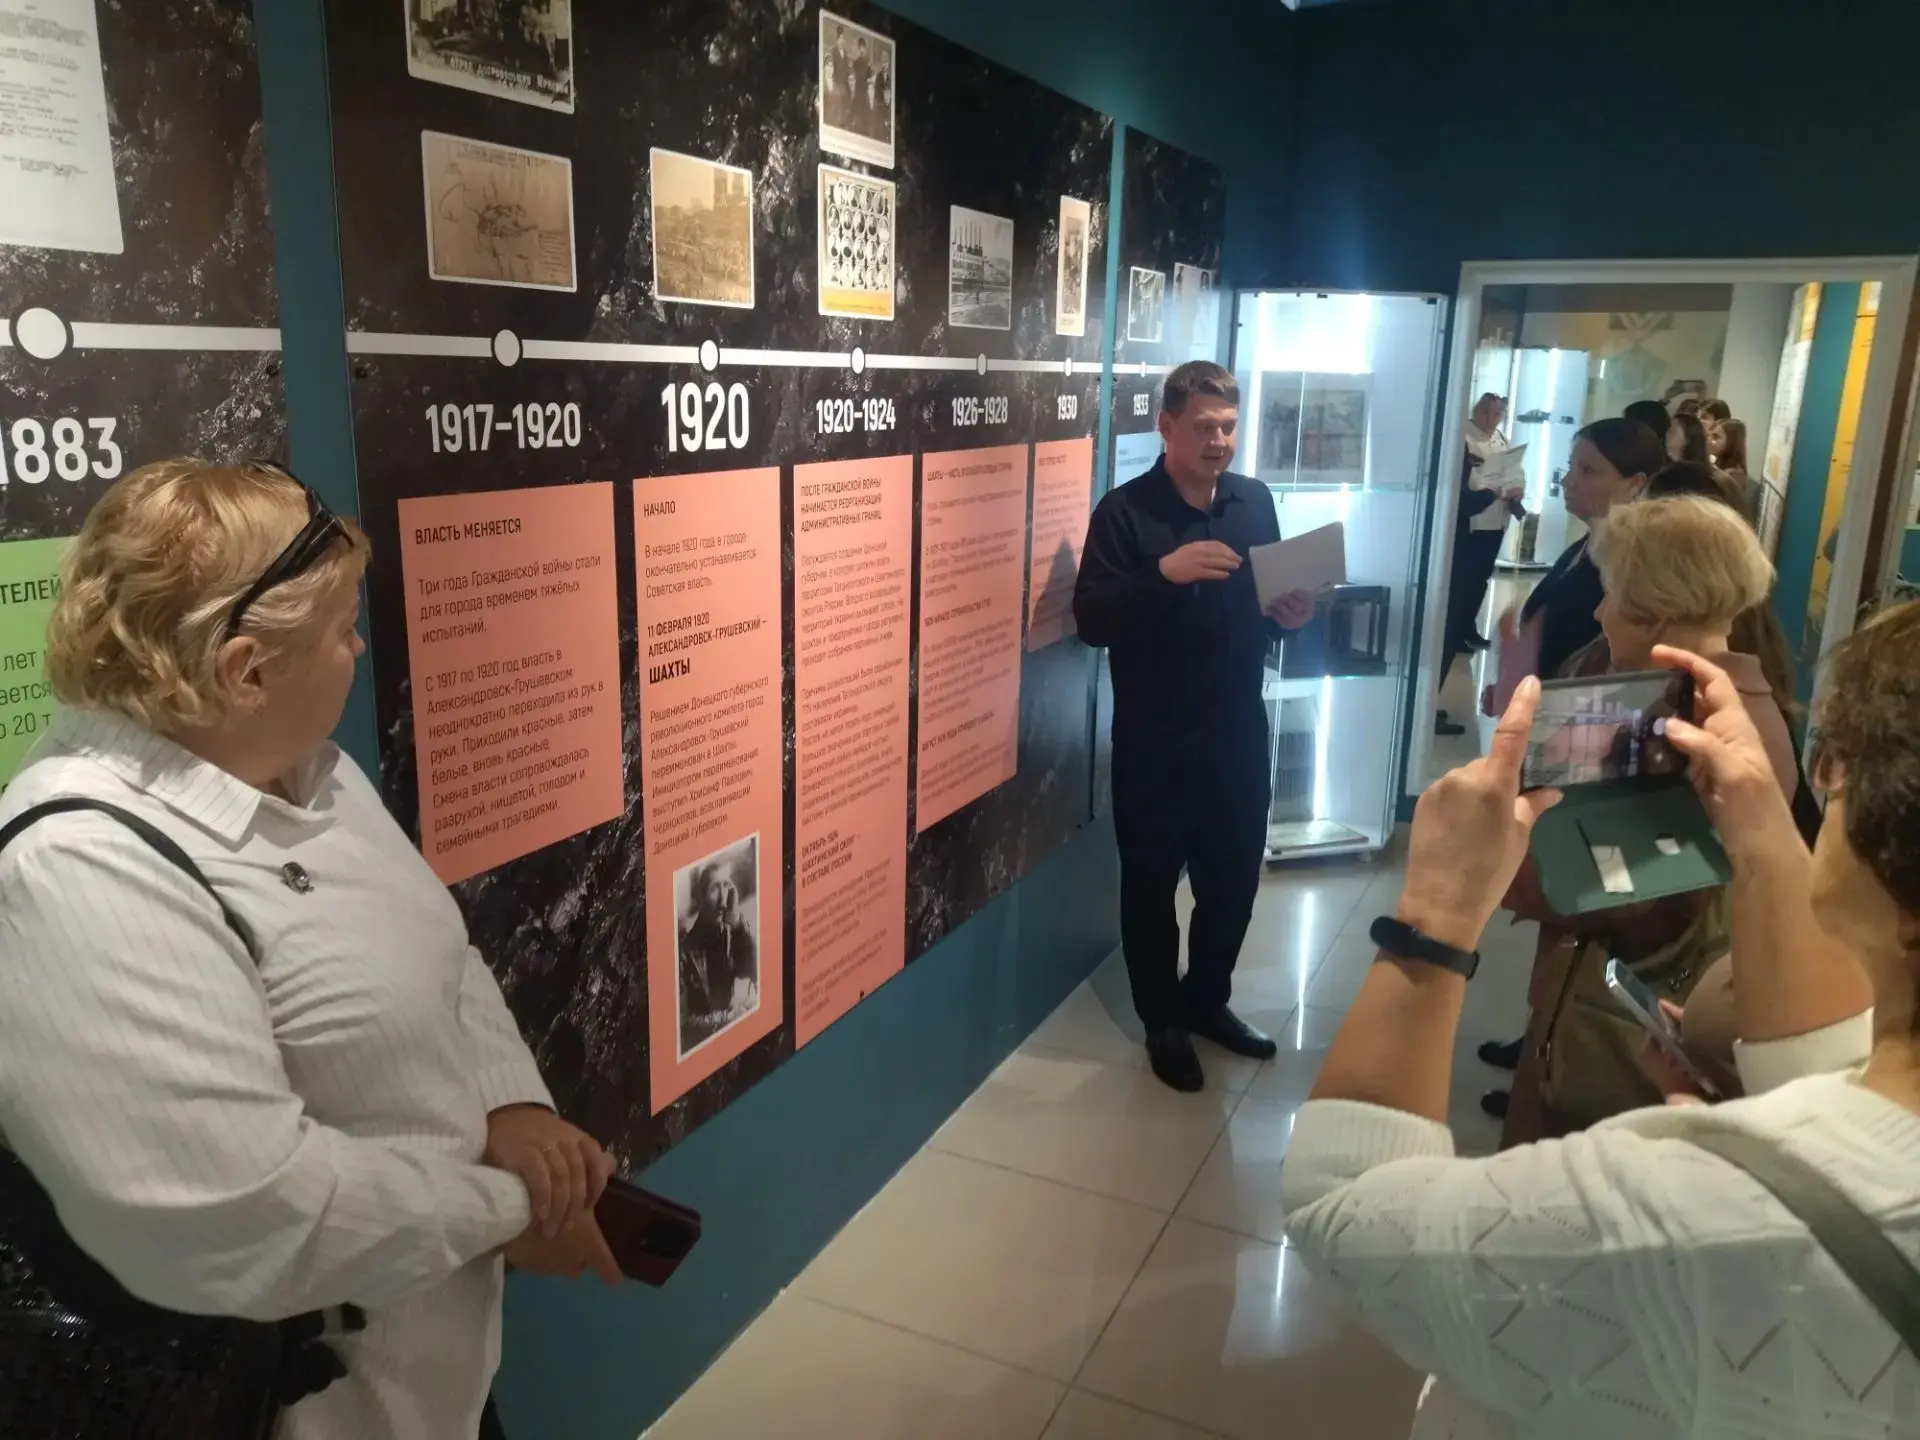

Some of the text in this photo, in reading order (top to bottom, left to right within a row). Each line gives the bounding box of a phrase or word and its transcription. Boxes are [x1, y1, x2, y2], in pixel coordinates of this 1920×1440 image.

[661, 382, 750, 453] 1920
[1057, 395, 1078, 420] 1930
[801, 484, 820, 497] ПОСЛЕ
[821, 477, 861, 494] ГРАЖДАНСКОЙ
[644, 500, 676, 517] НАЧАЛО
[415, 517, 521, 545] ВЛАСТЬ МЕНЯЕТСЯ
[645, 545, 651, 558] В
[652, 543, 680, 557] начале
[682, 537, 698, 552] 1920
[418, 554, 601, 597] Три года Гражданской войны стали
[645, 558, 698, 579] окончательно
[420, 580, 581, 621] для города временем тяжёлых
[646, 579, 686, 599] Советская
[422, 616, 487, 644] испытаний.
[647, 611, 711, 639] 11 ФЕВРАЛЯ 1920
[648, 615, 761, 658] АЛЕКСАНДРОВСК-ГРУШЕВСКИЙ
[4, 651, 36, 672] лет
[425, 649, 563, 692] С 1917 по 1920 год власть в
[649, 657, 690, 685] ШАХТЫ
[427, 667, 573, 716] Александровск-Грушевском
[429, 680, 604, 740] неоднократно переходила из рук в
[650, 703, 689, 724] Решением
[691, 689, 728, 711] Донецкого
[713, 702, 744, 721] комитета
[13, 712, 37, 736] 20
[462, 726, 519, 753] Приходили
[567, 704, 594, 722] затем
[472, 751, 504, 773] вновь
[652, 752, 706, 779] переименован
[433, 747, 590, 810] Смена власти сопровождалась
[539, 773, 577, 795] голодом
[579, 769, 586, 780] и
[436, 820, 499, 854] семейными
